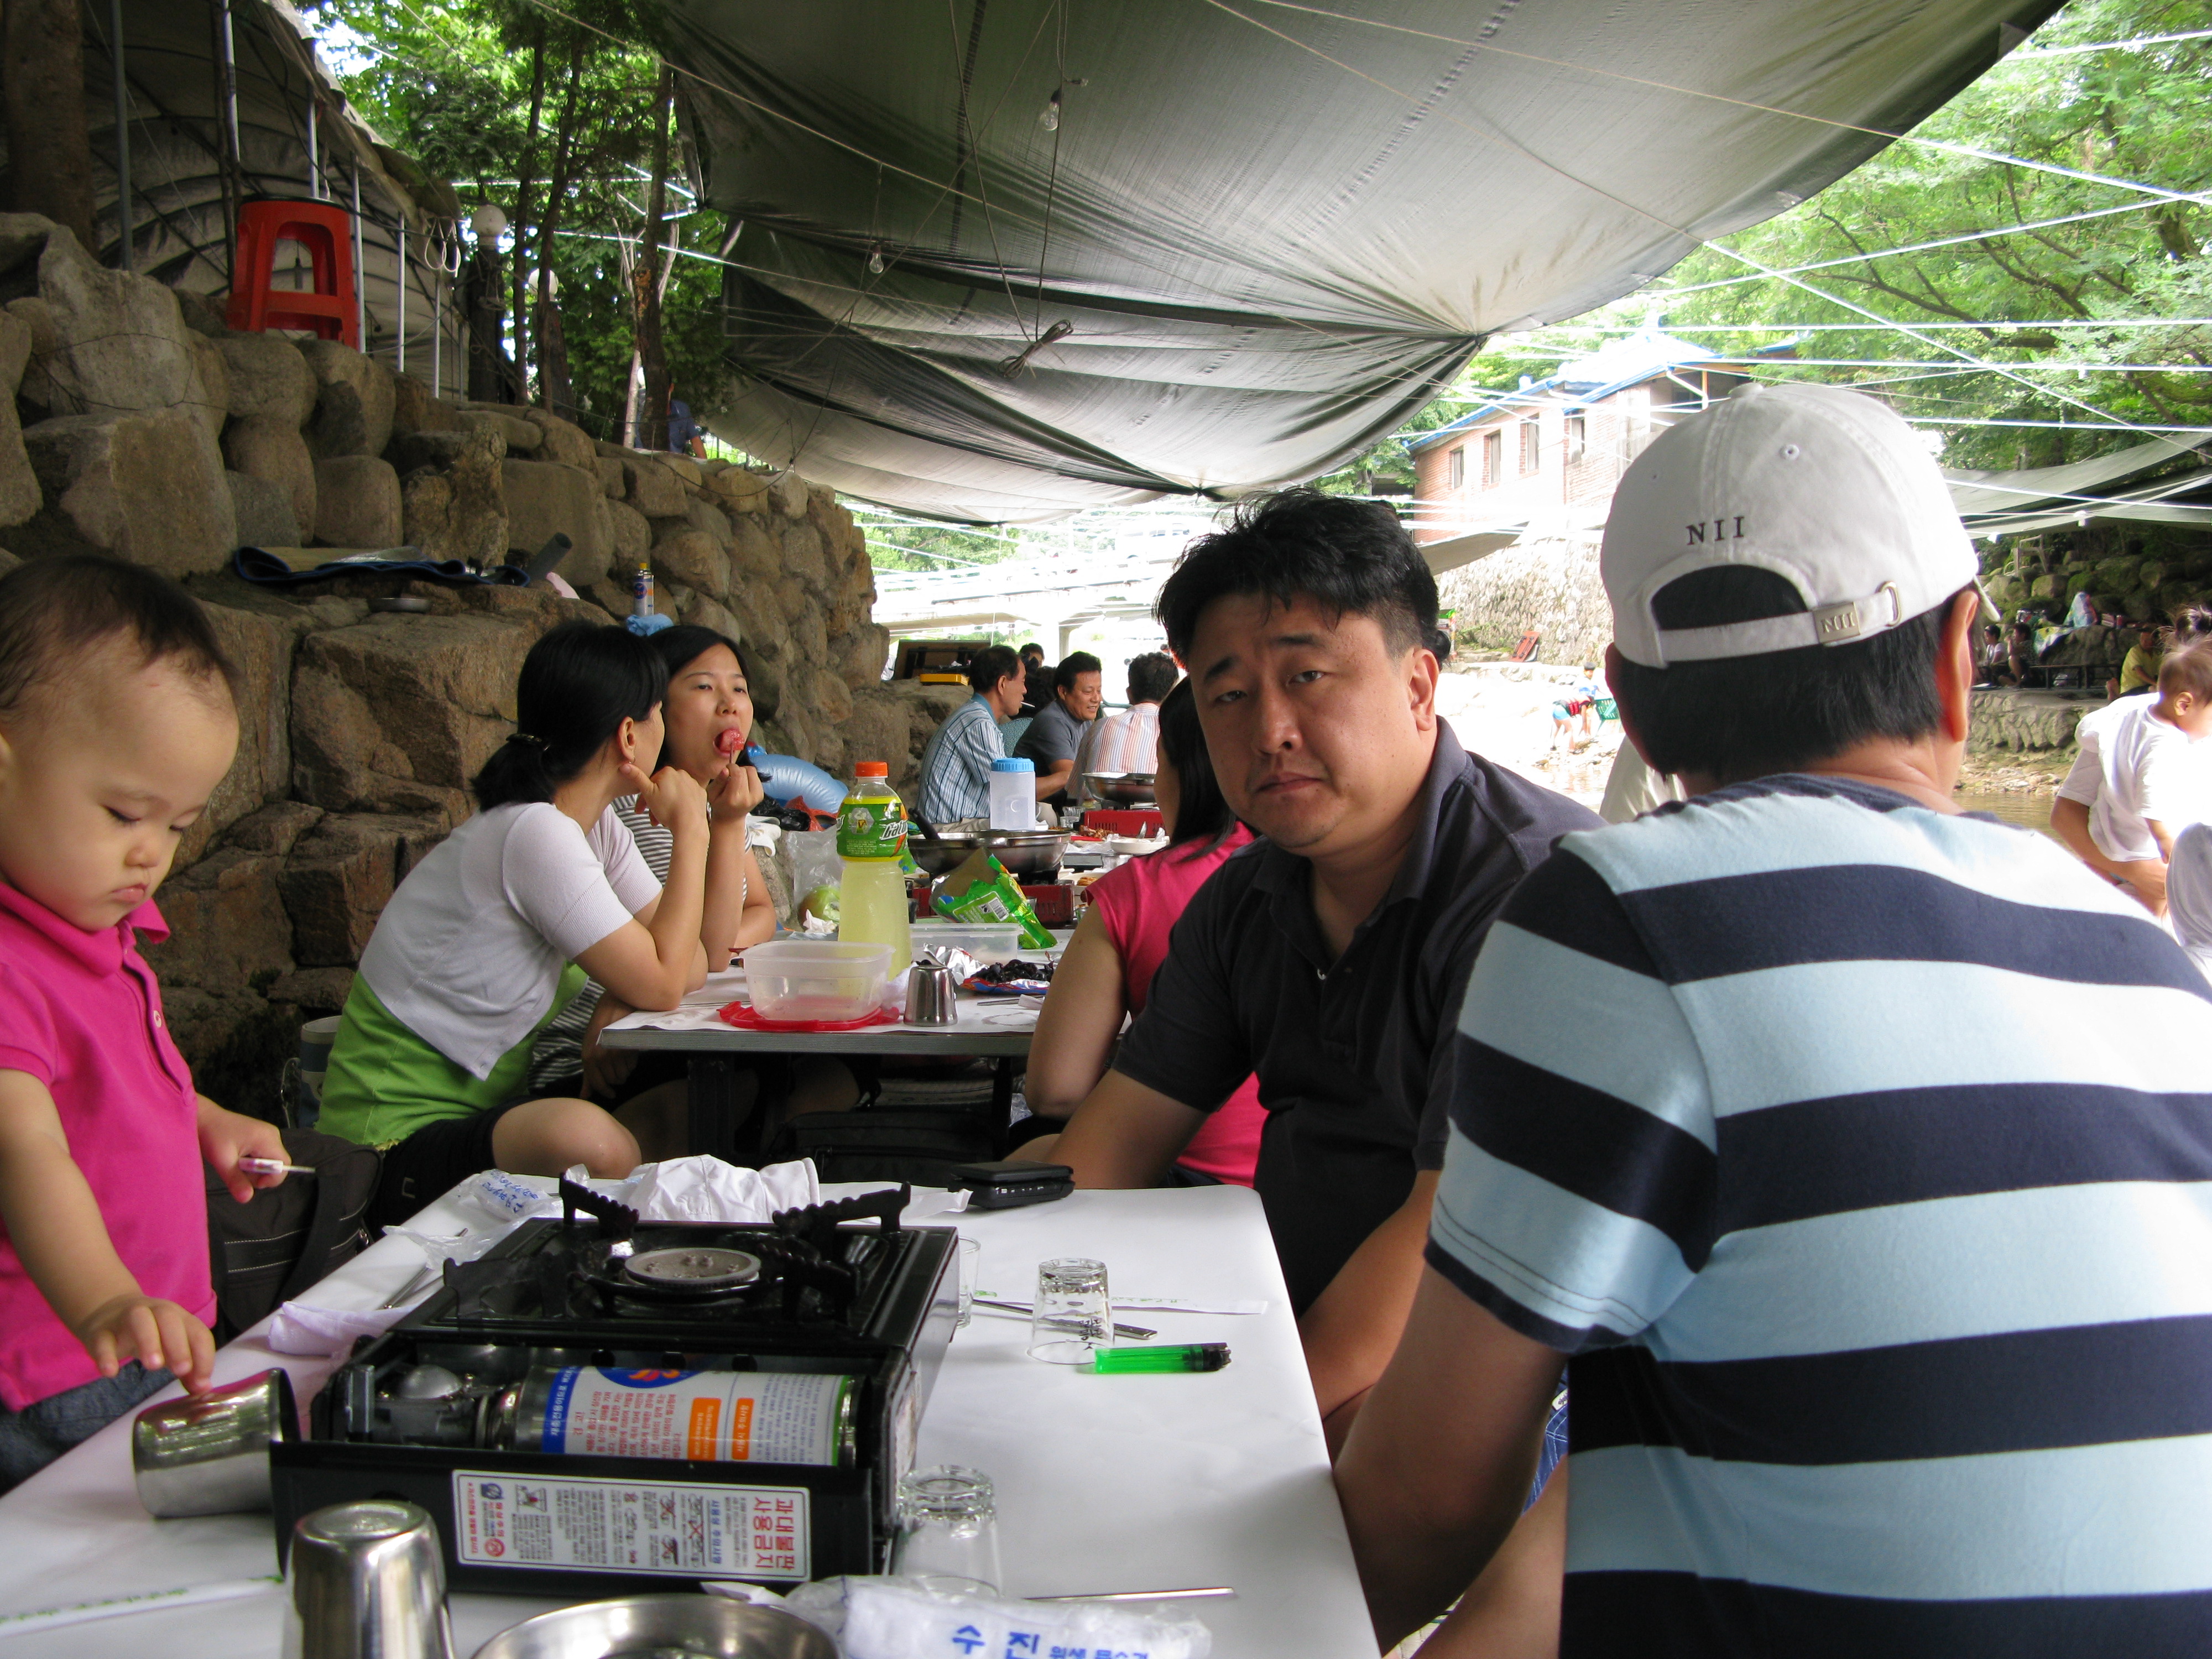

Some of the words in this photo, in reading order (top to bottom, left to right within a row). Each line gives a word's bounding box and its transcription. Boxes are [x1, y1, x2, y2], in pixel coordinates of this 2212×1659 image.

[1686, 517, 1746, 545] NII
[1820, 612, 1856, 633] NII
[753, 1496, 774, 1568] 사용금지
[775, 1498, 795, 1571] 과대불판
